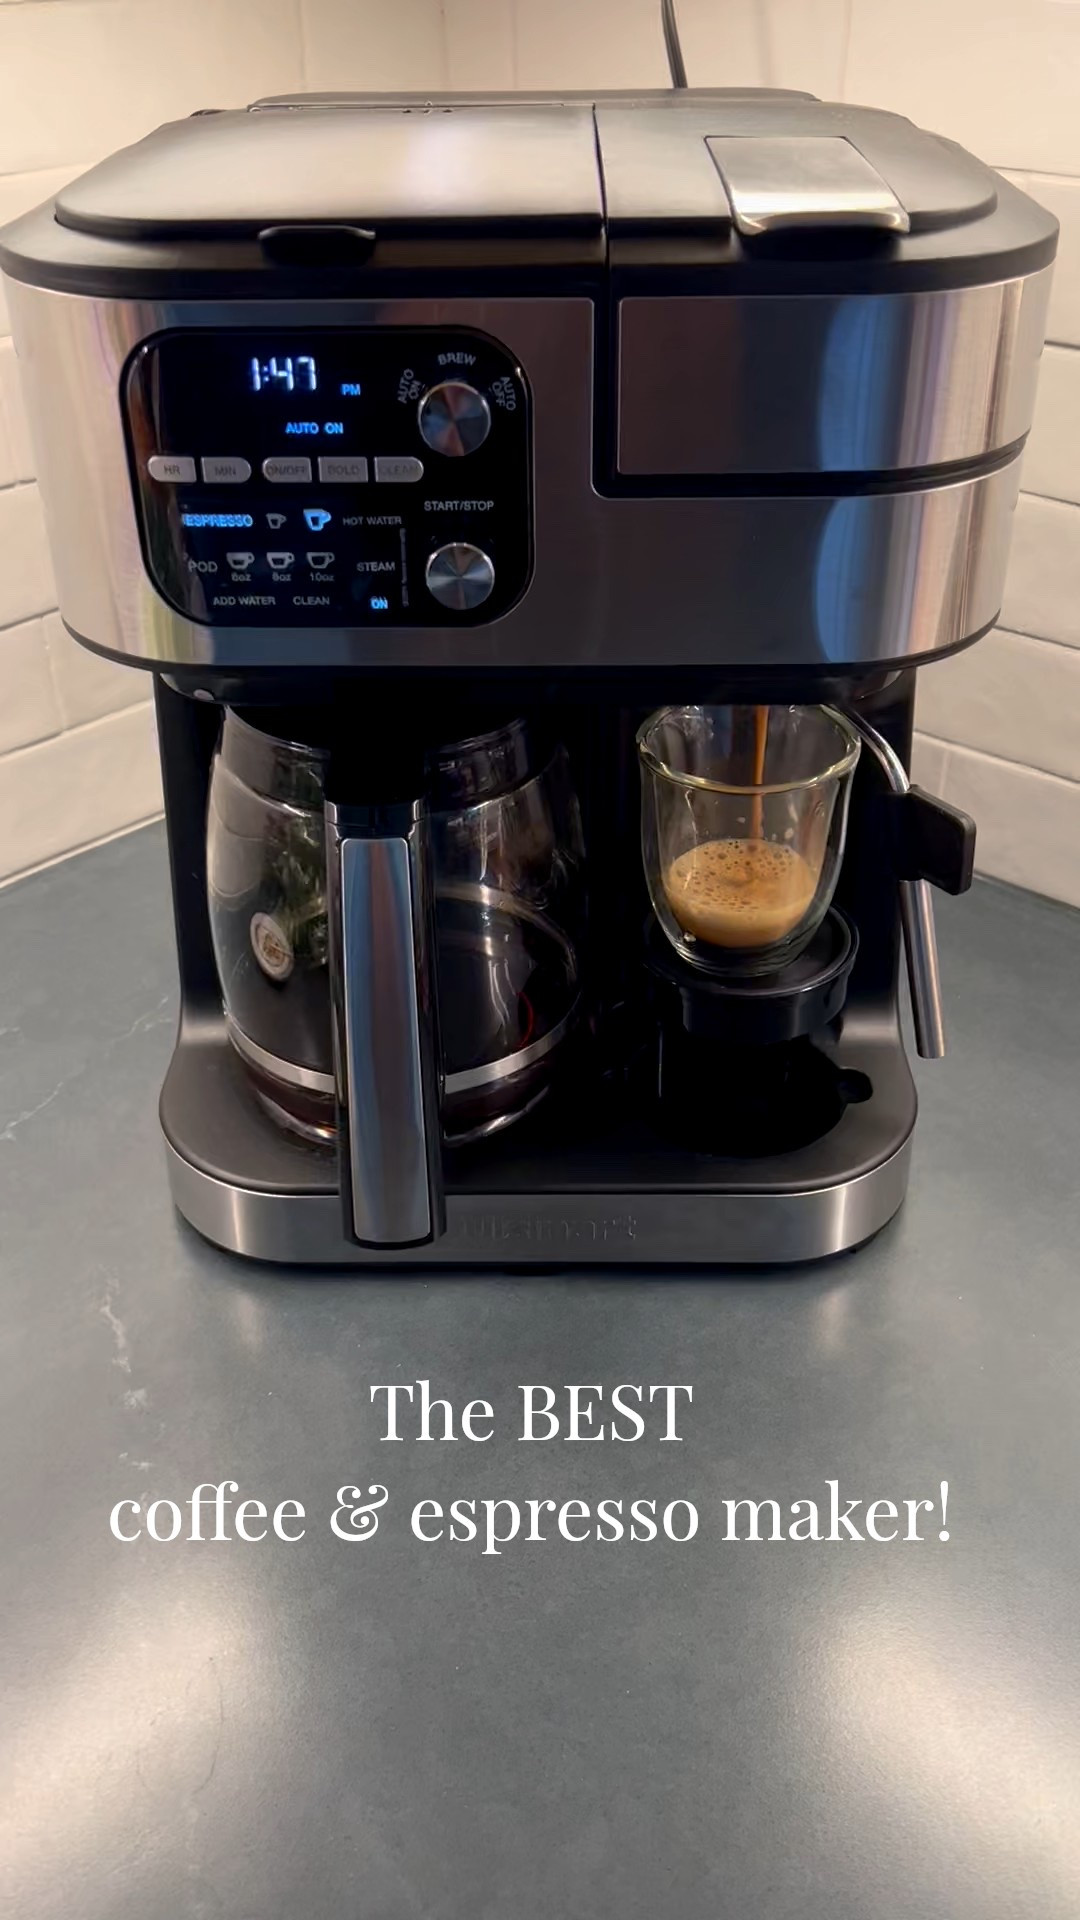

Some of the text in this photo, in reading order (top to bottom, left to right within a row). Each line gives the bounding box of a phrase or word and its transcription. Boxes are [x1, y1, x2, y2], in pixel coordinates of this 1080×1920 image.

[438, 352, 476, 366] BREW
[251, 356, 361, 396] 1:47 PM
[398, 368, 414, 404] AUTO
[408, 380, 421, 400] ON
[492, 382, 506, 407] OFF
[501, 377, 516, 411] AUTO
[285, 422, 344, 434] AUTO ON
[163, 463, 181, 476] HR
[214, 463, 237, 476] MIN
[327, 463, 360, 475] BOLD
[424, 500, 495, 511] START/STOP
[183, 513, 253, 527] ESPRESSO
[342, 515, 402, 526] HOT WATER
[188, 560, 218, 573] POD
[356, 561, 396, 572] STEAM
[309, 571, 335, 582] 10oz
[213, 596, 276, 606] ADD WATER
[292, 596, 330, 606] CLEAN
[370, 595, 389, 610] ON
